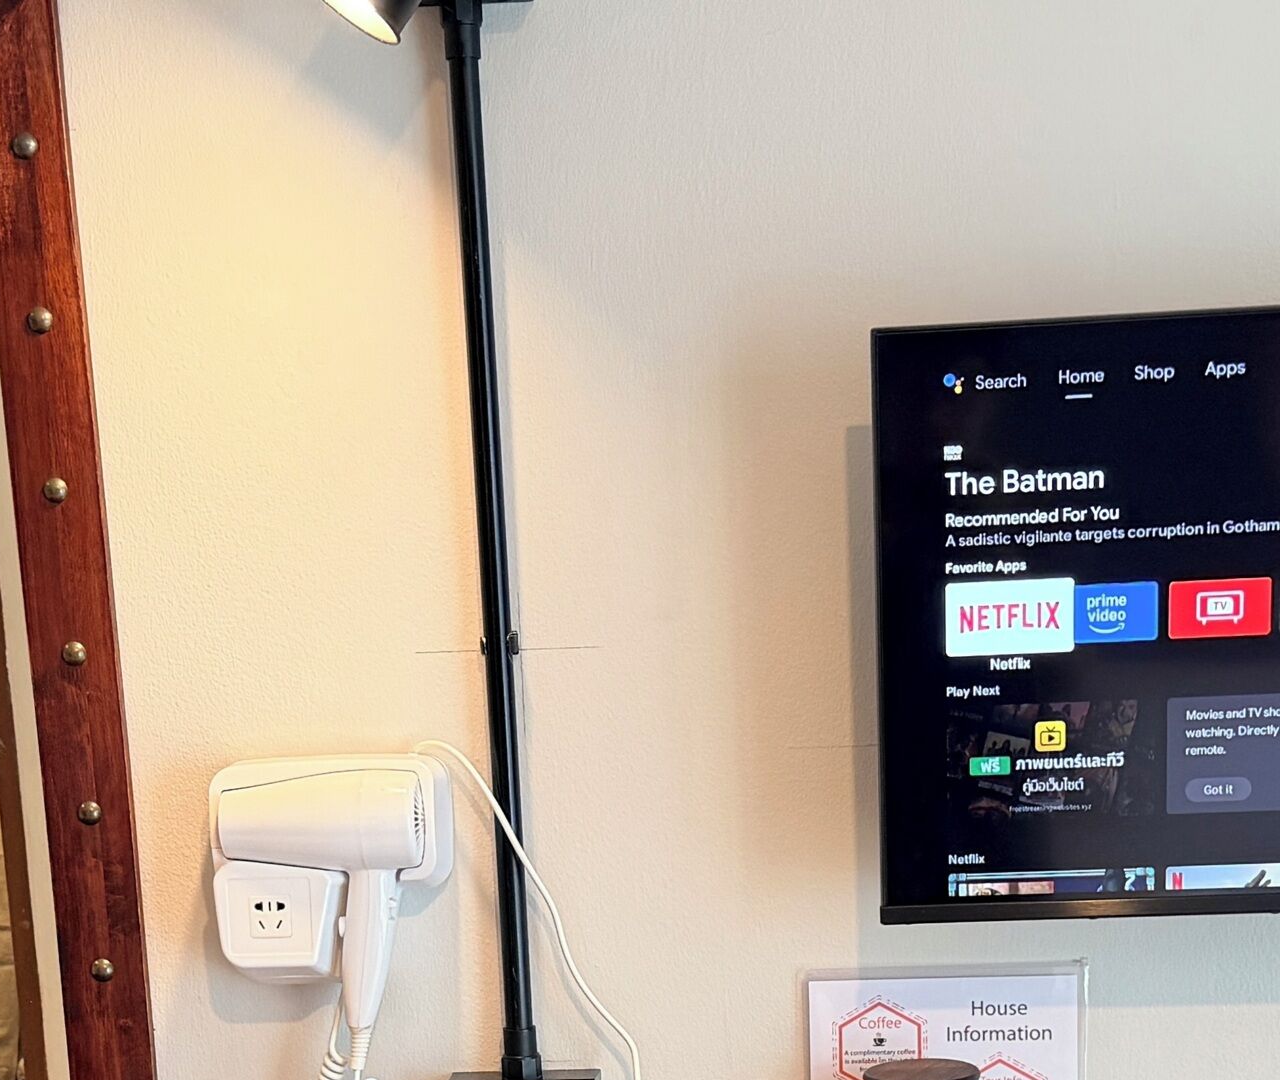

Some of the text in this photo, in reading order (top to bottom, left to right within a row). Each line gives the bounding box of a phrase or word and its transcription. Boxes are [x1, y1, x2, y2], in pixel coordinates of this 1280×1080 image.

[1058, 370, 1105, 385] Home
[1134, 365, 1175, 382] Shop
[1204, 362, 1246, 378] Apps
[975, 374, 1027, 390] Search
[944, 469, 1105, 496] The Batman
[945, 505, 1120, 528] Recommended For You
[945, 535, 956, 547] A
[958, 532, 1011, 547] sadistic
[1015, 529, 1072, 547] vigilante
[1075, 528, 1125, 543] targets
[1127, 522, 1204, 540] corruption
[1206, 521, 1220, 534] in
[1222, 519, 1280, 534] Gotham
[945, 560, 1027, 574] Favorite Apps
[1086, 594, 1127, 610] prime
[1213, 601, 1228, 611] TV
[959, 601, 1060, 634] NETFLIX
[1088, 609, 1126, 622] video
[990, 657, 1030, 671] Netflix
[946, 685, 1000, 700] Play Next
[1185, 709, 1224, 721] Movies
[1226, 707, 1246, 719] and
[1247, 707, 1263, 718] TV
[1185, 726, 1236, 739] watching.
[1237, 725, 1279, 737] Directly
[1185, 745, 1226, 756] remote.
[981, 751, 1125, 774] ฟรี ภาพยนตร์และทีวี
[1203, 784, 1233, 795] Got it
[948, 853, 985, 865] Netflix
[971, 1001, 1028, 1016] House
[858, 1017, 902, 1029] Coffee
[946, 1025, 1053, 1042] Information
[850, 1049, 896, 1057] complimentary
